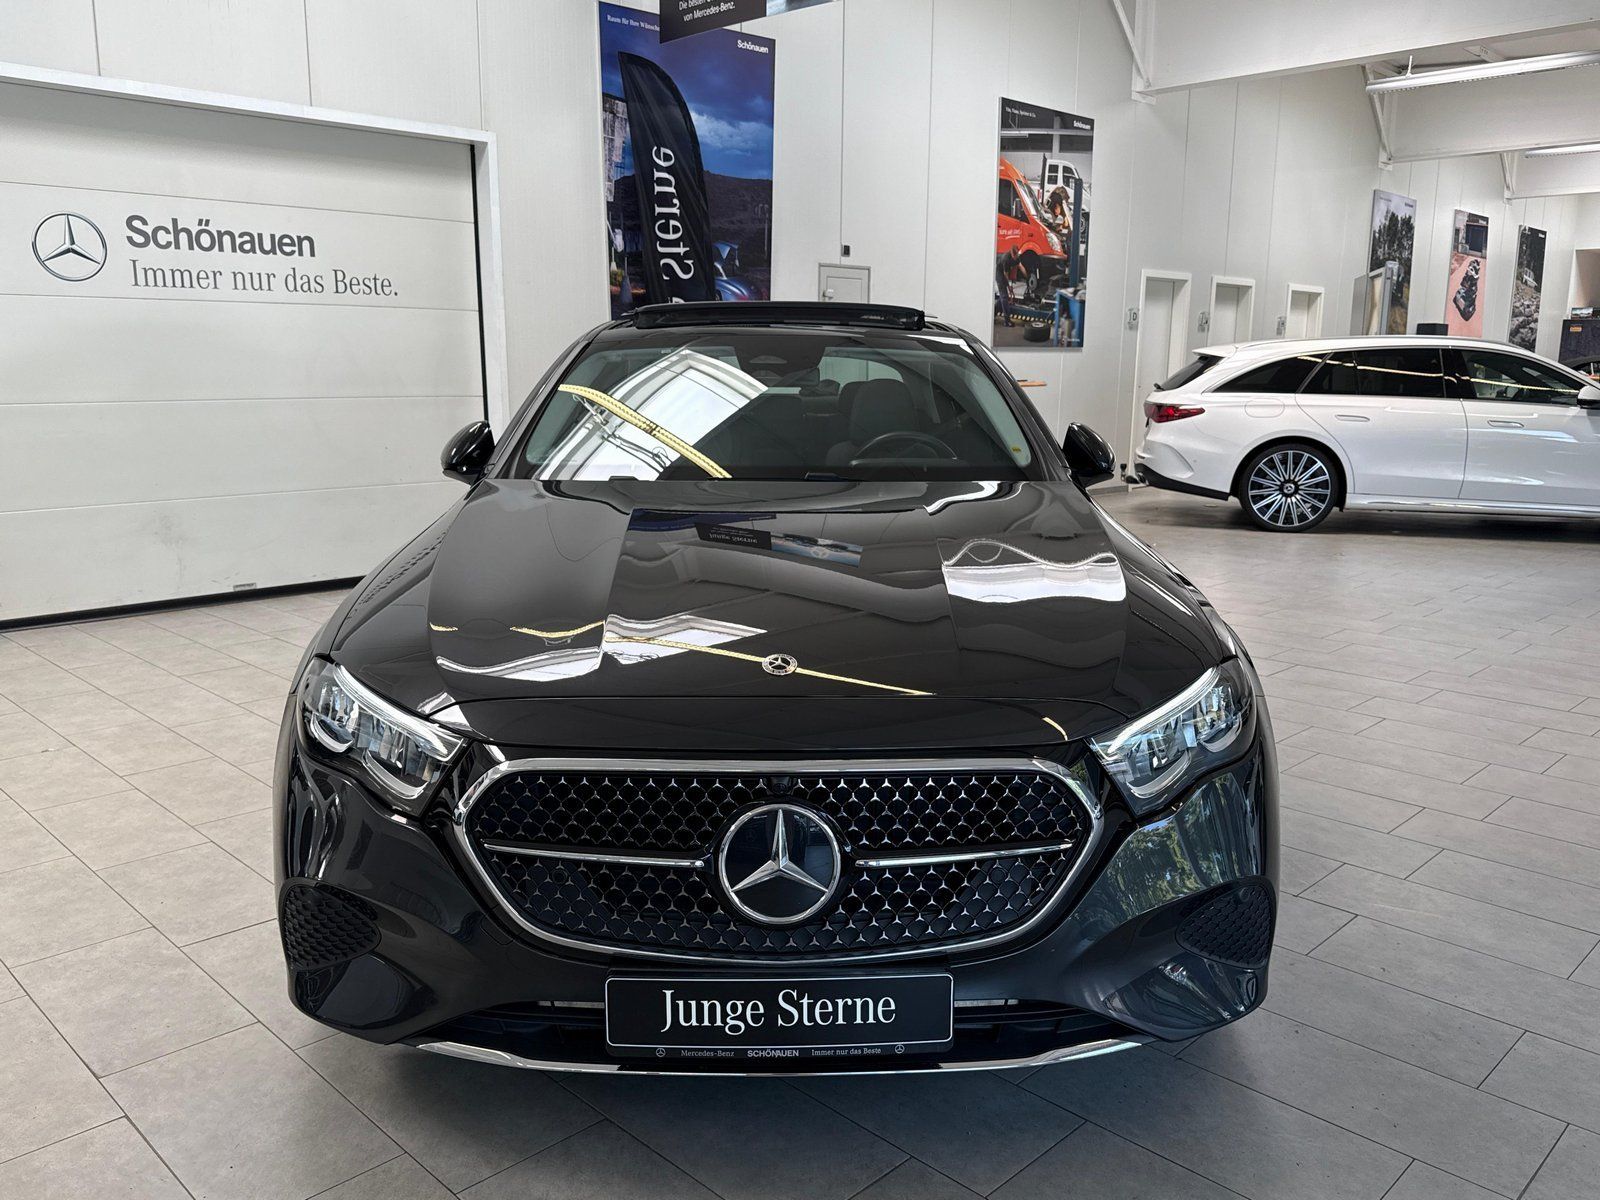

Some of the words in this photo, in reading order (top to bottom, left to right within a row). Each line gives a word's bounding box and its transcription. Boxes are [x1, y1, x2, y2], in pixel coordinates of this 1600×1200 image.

[679, 0, 688, 10] Die
[683, 13, 693, 21] von
[694, 2, 736, 19] Mercedes-Benz.
[737, 40, 769, 53] Schönauen
[125, 214, 316, 257] Schönauen
[129, 259, 223, 290] Immer
[231, 267, 276, 292] nur
[284, 267, 325, 294] das
[332, 269, 399, 297] Beste.
[660, 989, 765, 1036] Junge
[777, 989, 897, 1028] Sterne
[680, 1049, 735, 1057] Mercedes-Benz
[747, 1049, 799, 1058] SCHÖNAUEN
